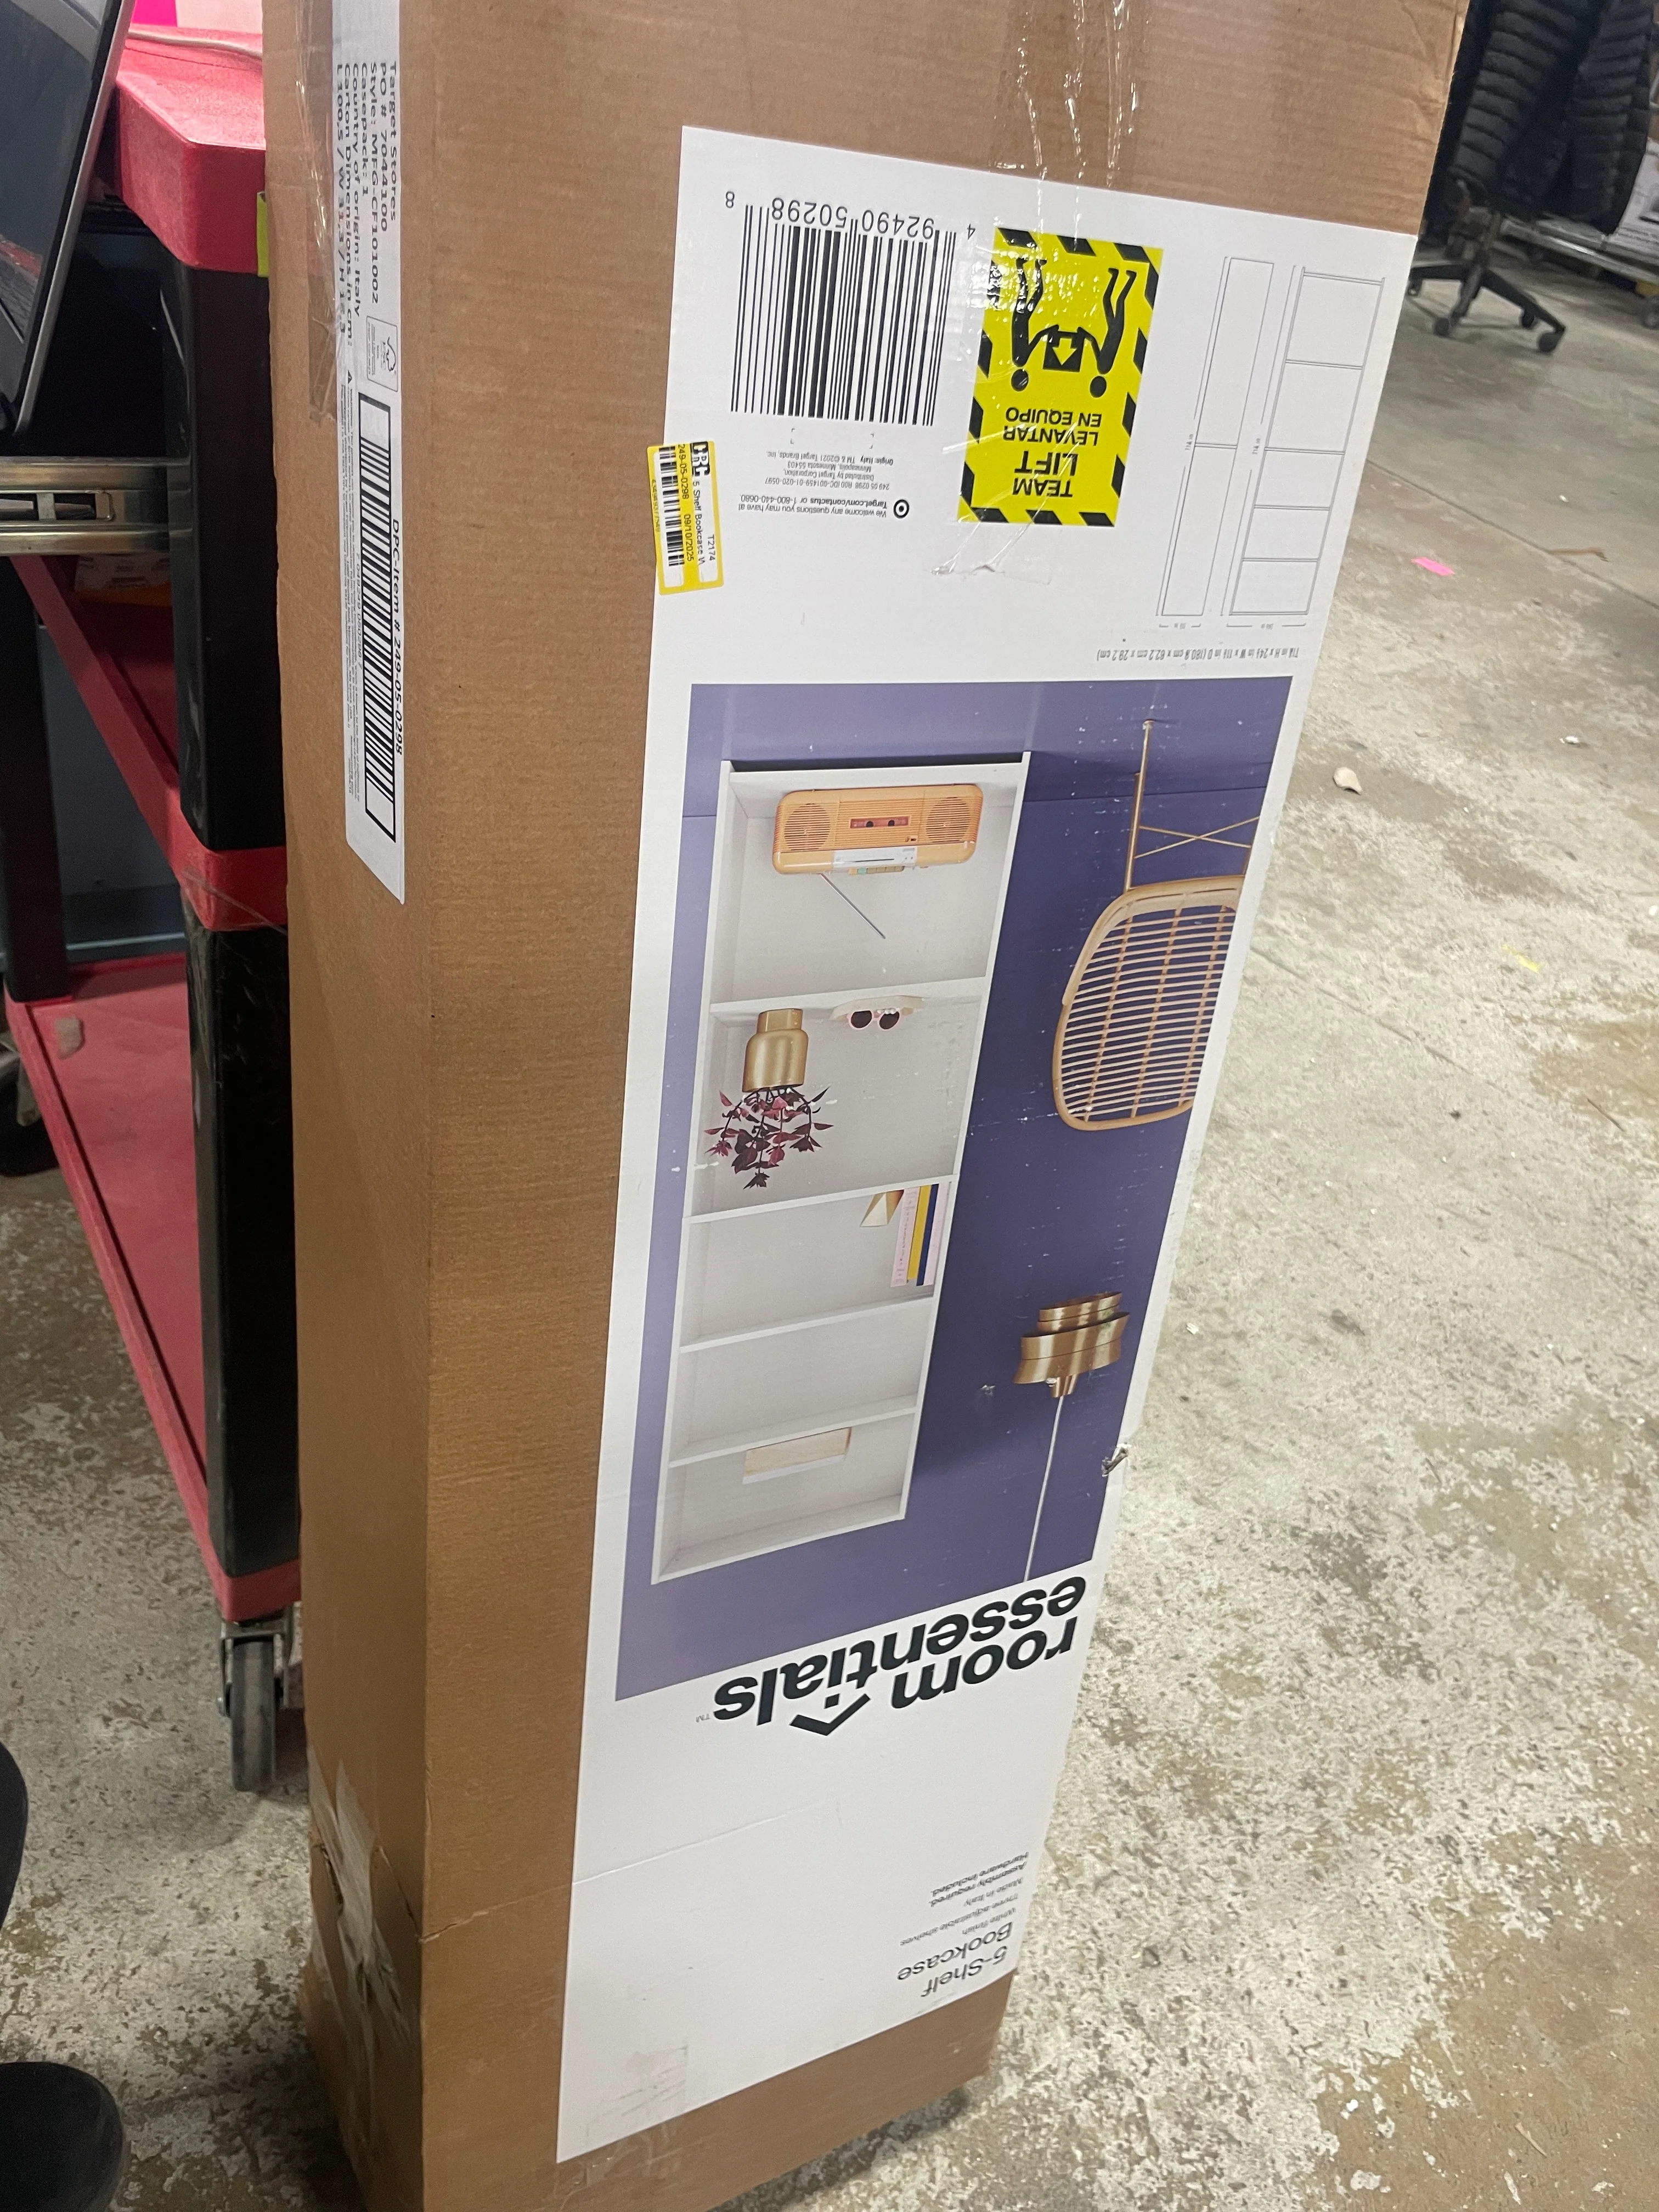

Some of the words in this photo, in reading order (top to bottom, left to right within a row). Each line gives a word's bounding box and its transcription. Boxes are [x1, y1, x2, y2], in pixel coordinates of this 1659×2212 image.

[337, 64, 342, 75] L
[380, 63, 386, 95] PO
[381, 104, 386, 117] #
[339, 167, 344, 190] W
[354, 160, 360, 184] of
[363, 187, 368, 196] 1
[725, 191, 735, 208] 8
[771, 198, 848, 228] 50298
[861, 210, 934, 240] 92490
[966, 224, 976, 240] 4
[340, 267, 345, 282] H
[347, 283, 352, 301] in
[1005, 407, 1073, 426] EQUIPO
[1078, 413, 1102, 427] EN
[1003, 425, 1098, 446] LEVANTAR
[778, 450, 799, 460] Brands,
[800, 452, 817, 462] Target
[860, 455, 873, 465] Italy
[874, 457, 894, 466] Origin:
[787, 461, 806, 469] 55403
[808, 462, 836, 471] Minnesota
[1014, 451, 1078, 476] LIFT
[678, 444, 690, 499] 249-05-0298
[783, 469, 817, 478] Corporation,
[819, 471, 835, 479] Target
[837, 471, 844, 479] by
[845, 473, 874, 482] Distributed
[1012, 478, 1073, 498] TEAM
[693, 490, 702, 511] Shelf
[765, 504, 780, 512] may
[782, 504, 794, 512] you
[810, 498, 887, 509] Target.com/contactus
[747, 504, 763, 513] have
[797, 506, 830, 515] questions
[831, 507, 843, 515] any
[844, 509, 874, 517] welcome
[683, 514, 694, 562] 09/10/2025
[695, 514, 704, 555] Bookcase
[707, 534, 715, 561] T2174
[394, 619, 400, 632] #
[1096, 649, 1111, 662] cm)
[1148, 650, 1165, 661] 62.2
[1173, 649, 1184, 657] cm
[394, 636, 402, 755] 249-05-0298
[713, 1577, 1086, 1726] essentials
[891, 1616, 1077, 1709] room
[979, 1852, 1029, 1876] Hardware
[977, 1861, 1027, 1887] Assembly
[930, 1874, 978, 1897] included.
[996, 1877, 1023, 1893] Made
[928, 1884, 976, 1908] required.
[963, 1894, 985, 1907] Italy
[986, 1889, 994, 1898] in
[939, 1905, 991, 1931] adjustable
[962, 1920, 989, 1935] finish
[900, 1927, 938, 1946] shelves
[897, 1922, 1013, 1980] Bookcase
[921, 1945, 1007, 1997] 5-Shelf
